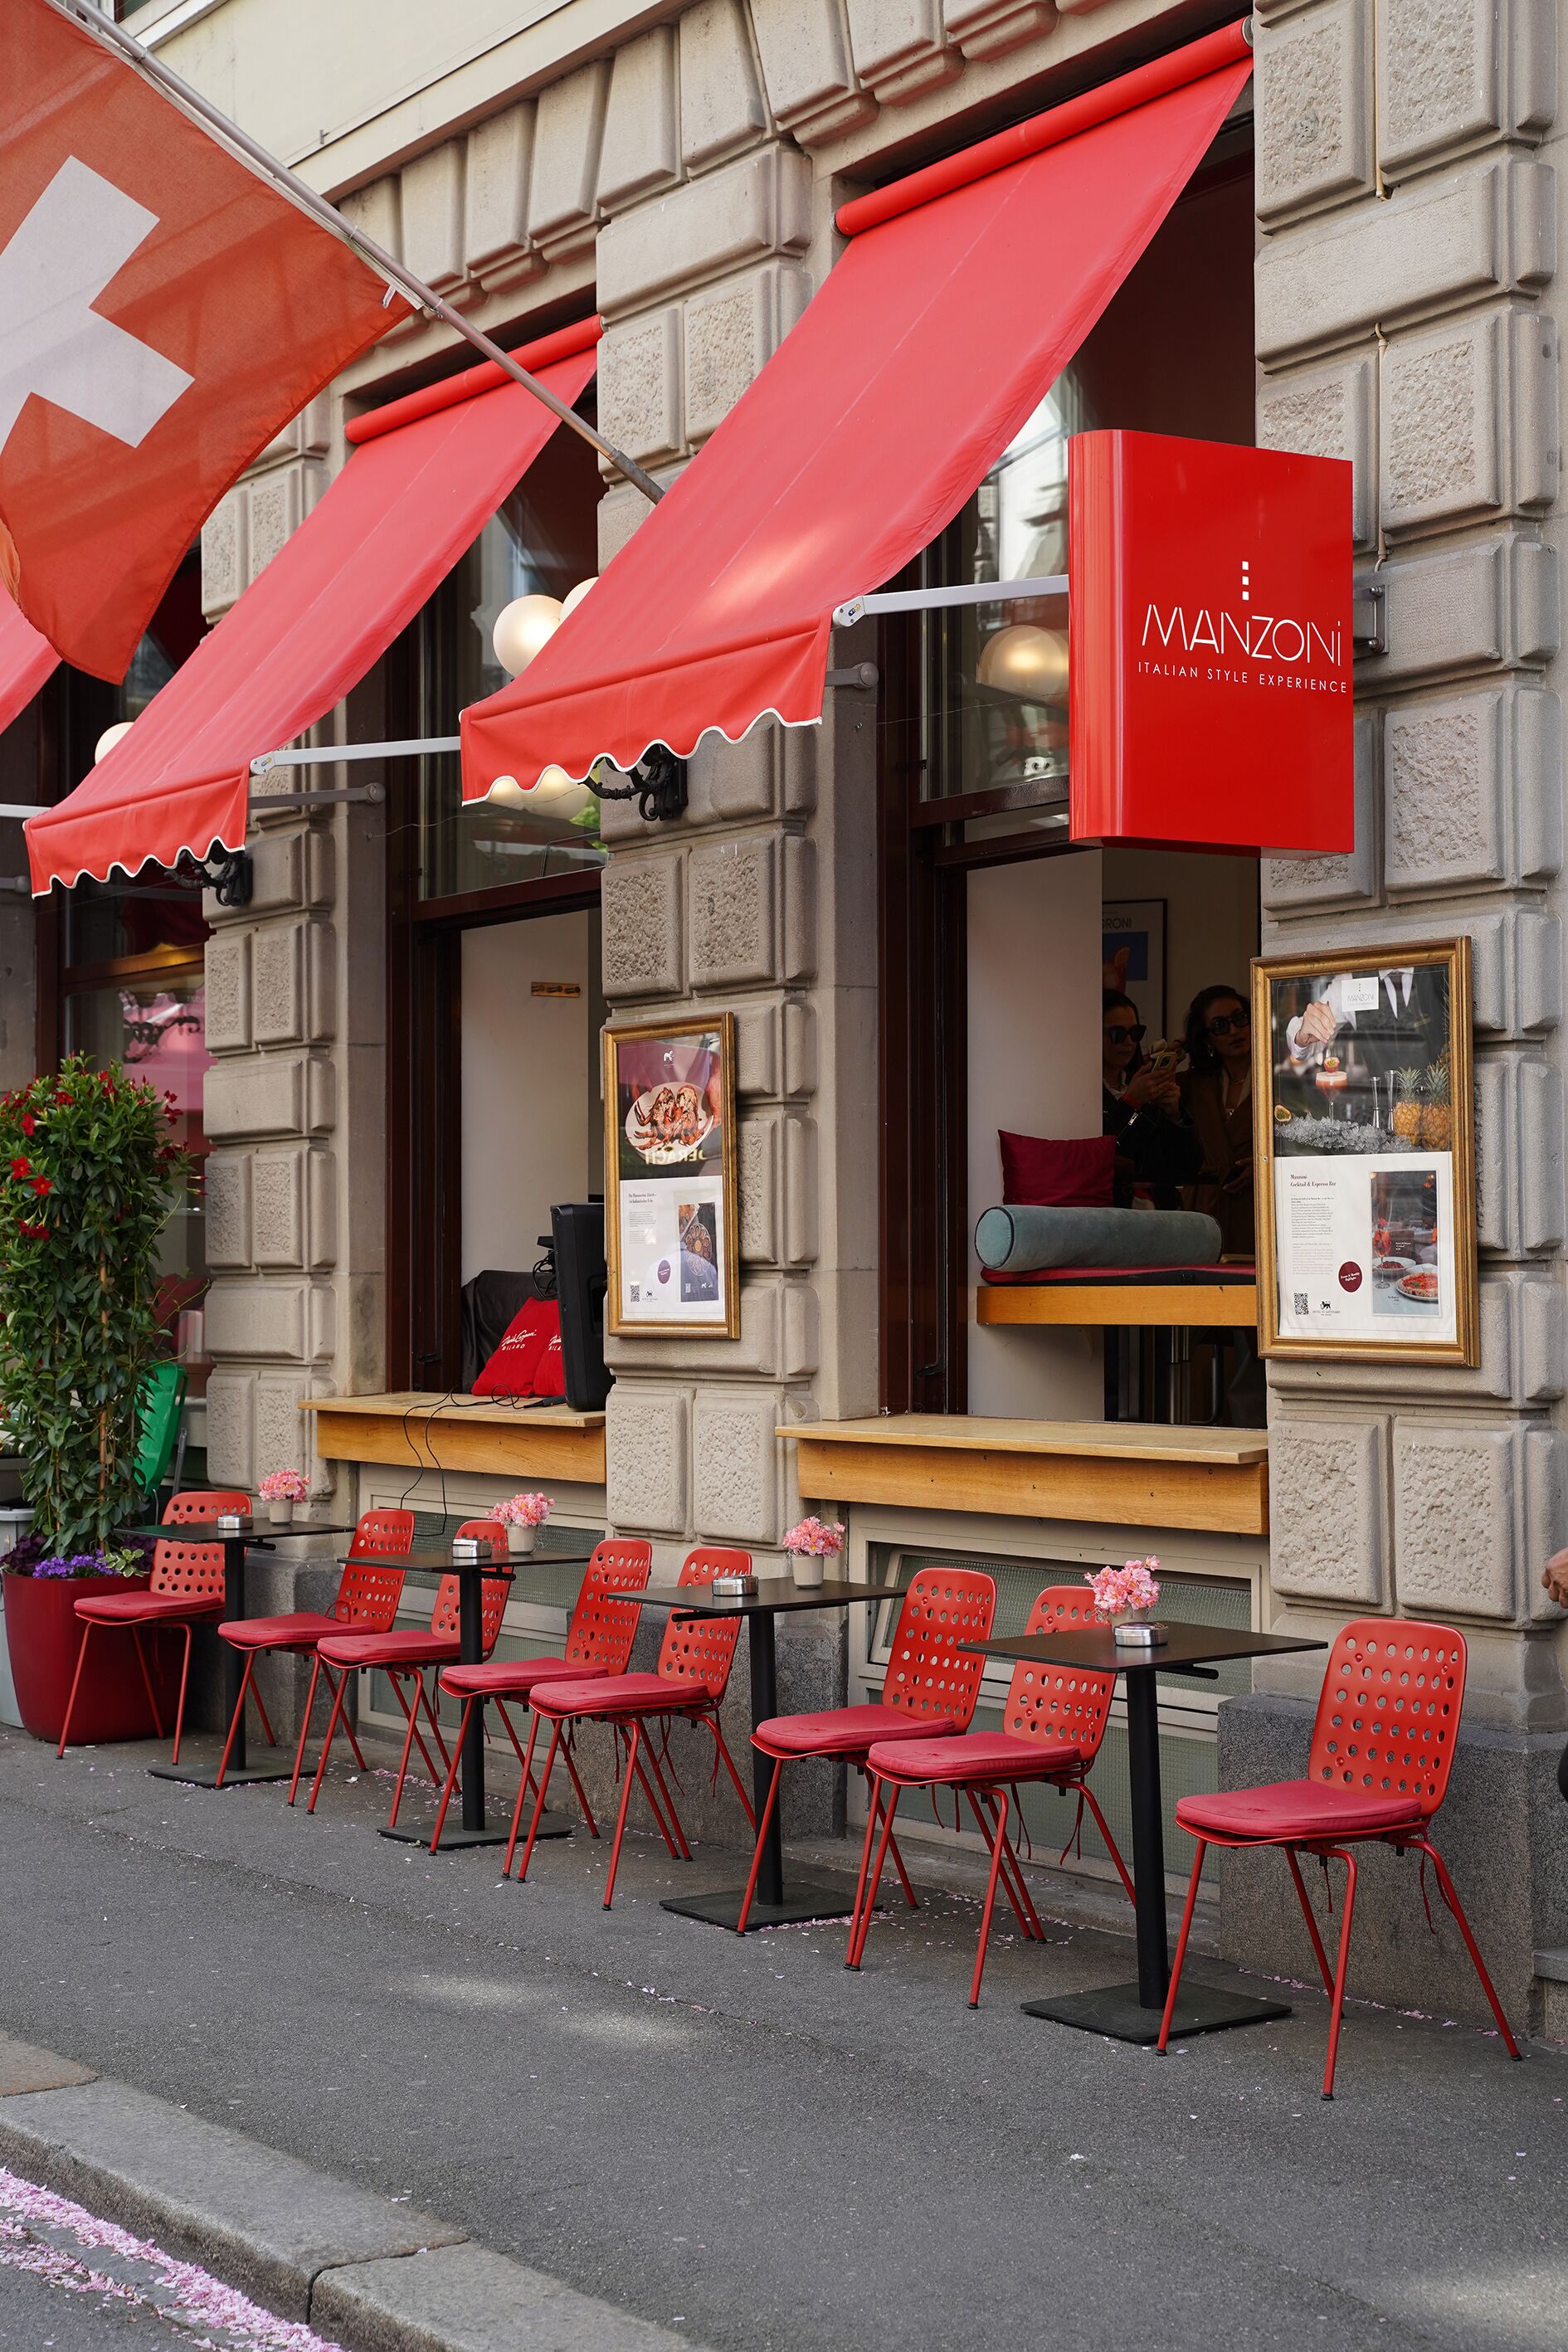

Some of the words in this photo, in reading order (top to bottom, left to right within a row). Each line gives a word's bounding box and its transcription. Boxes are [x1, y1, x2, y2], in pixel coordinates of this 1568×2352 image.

[1138, 661, 1198, 678] ITALIAN
[1207, 668, 1248, 684] STYLE
[1259, 674, 1347, 694] EXPERIENCE
[501, 1343, 525, 1351] MILANO
